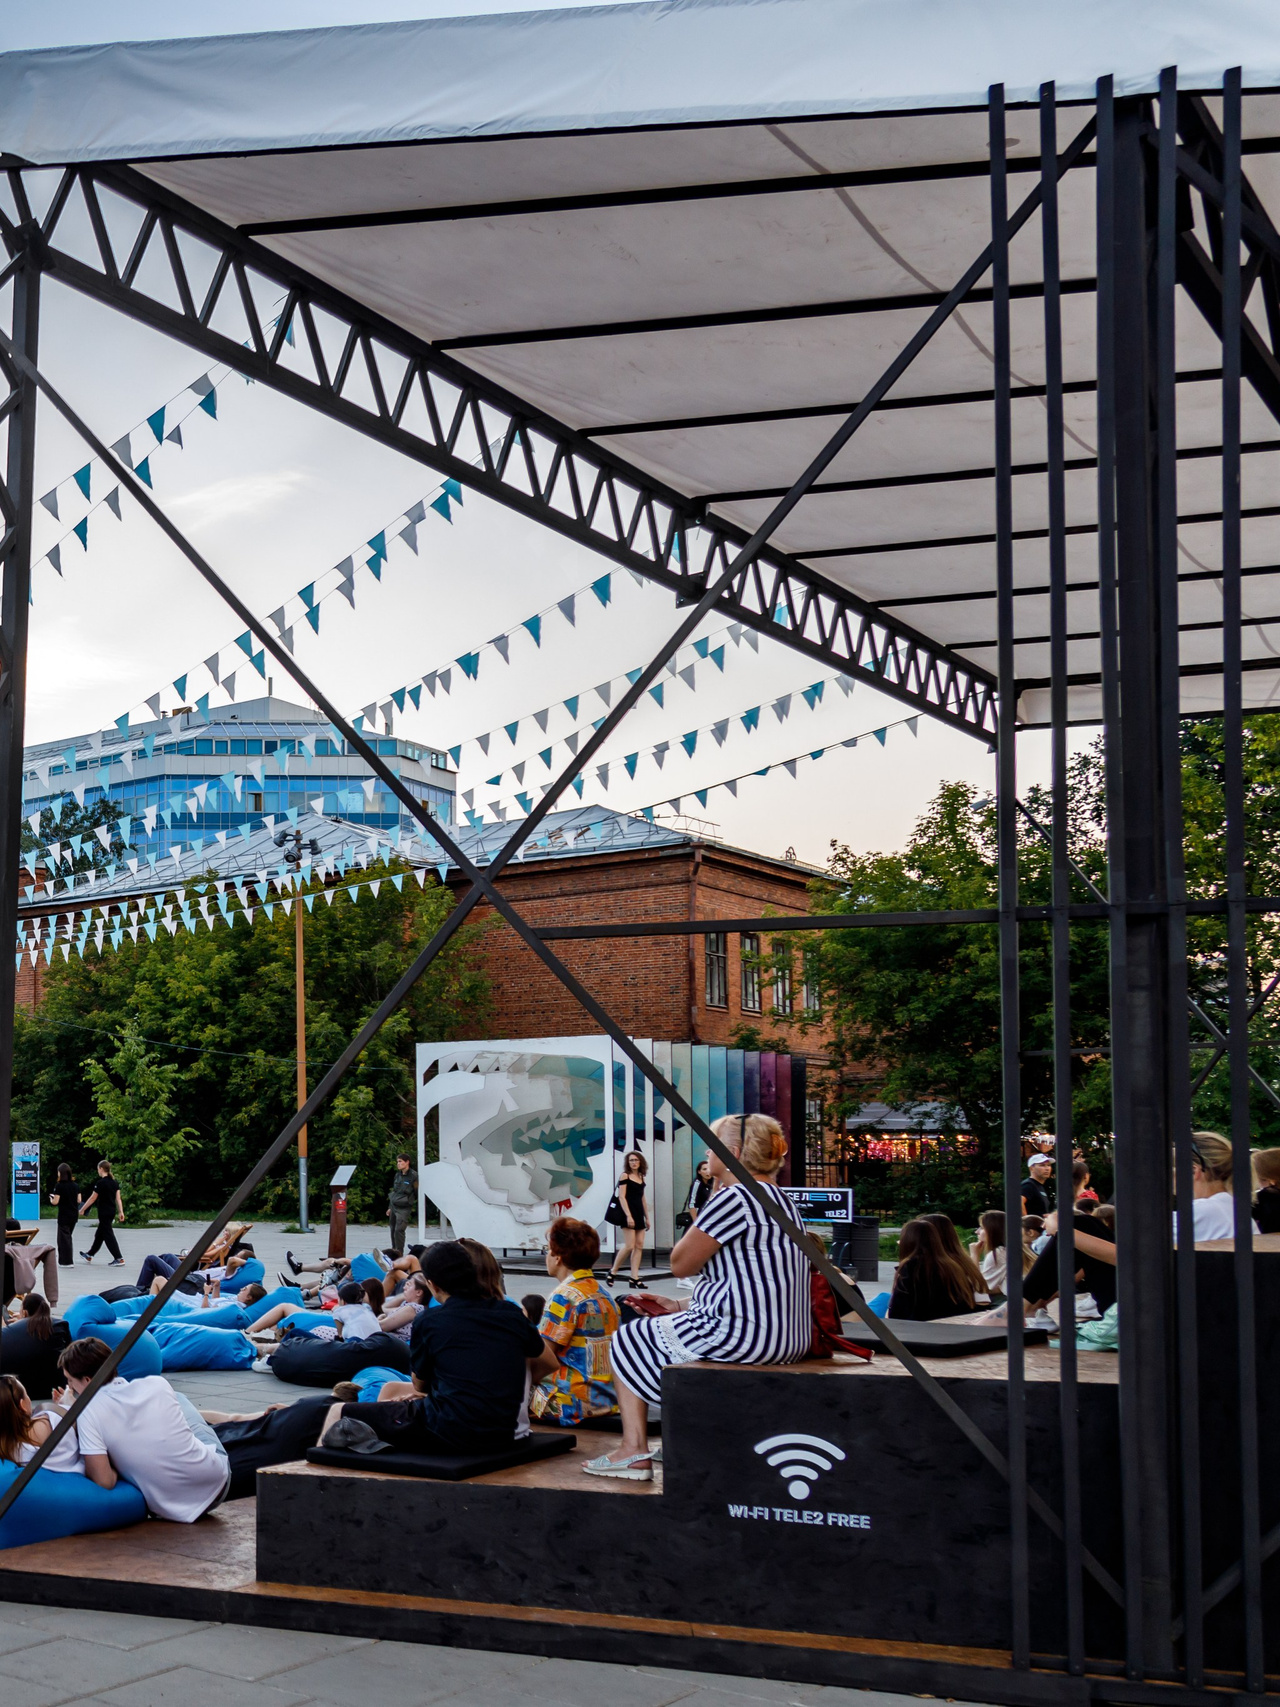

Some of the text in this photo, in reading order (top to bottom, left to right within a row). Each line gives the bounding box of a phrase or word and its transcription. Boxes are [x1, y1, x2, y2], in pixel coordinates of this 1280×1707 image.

[825, 1209, 847, 1218] TELE2
[727, 1503, 871, 1529] WI-FI TELE2 FREE
